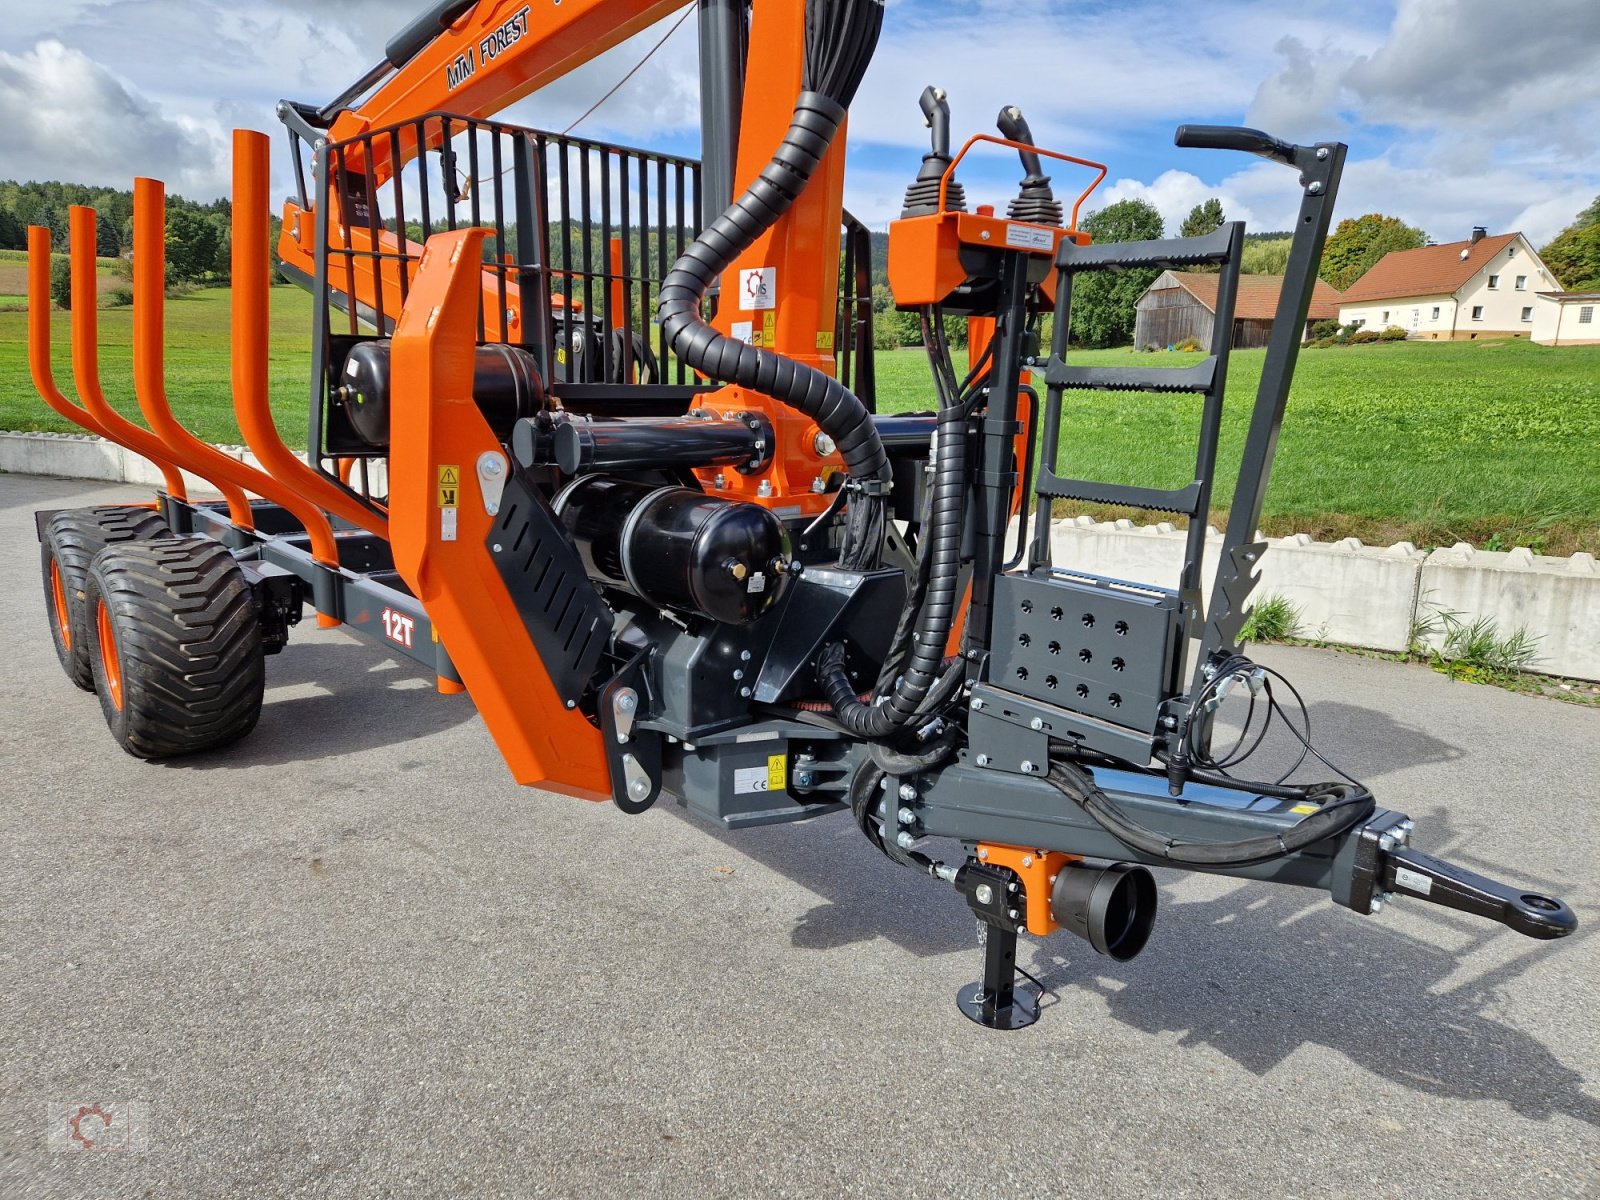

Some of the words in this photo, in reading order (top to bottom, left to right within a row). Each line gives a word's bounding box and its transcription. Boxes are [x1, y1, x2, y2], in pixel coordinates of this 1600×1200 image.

[446, 46, 476, 92] MTM
[479, 4, 531, 67] FOREST
[382, 607, 415, 648] 12T
[753, 780, 767, 790] CE
